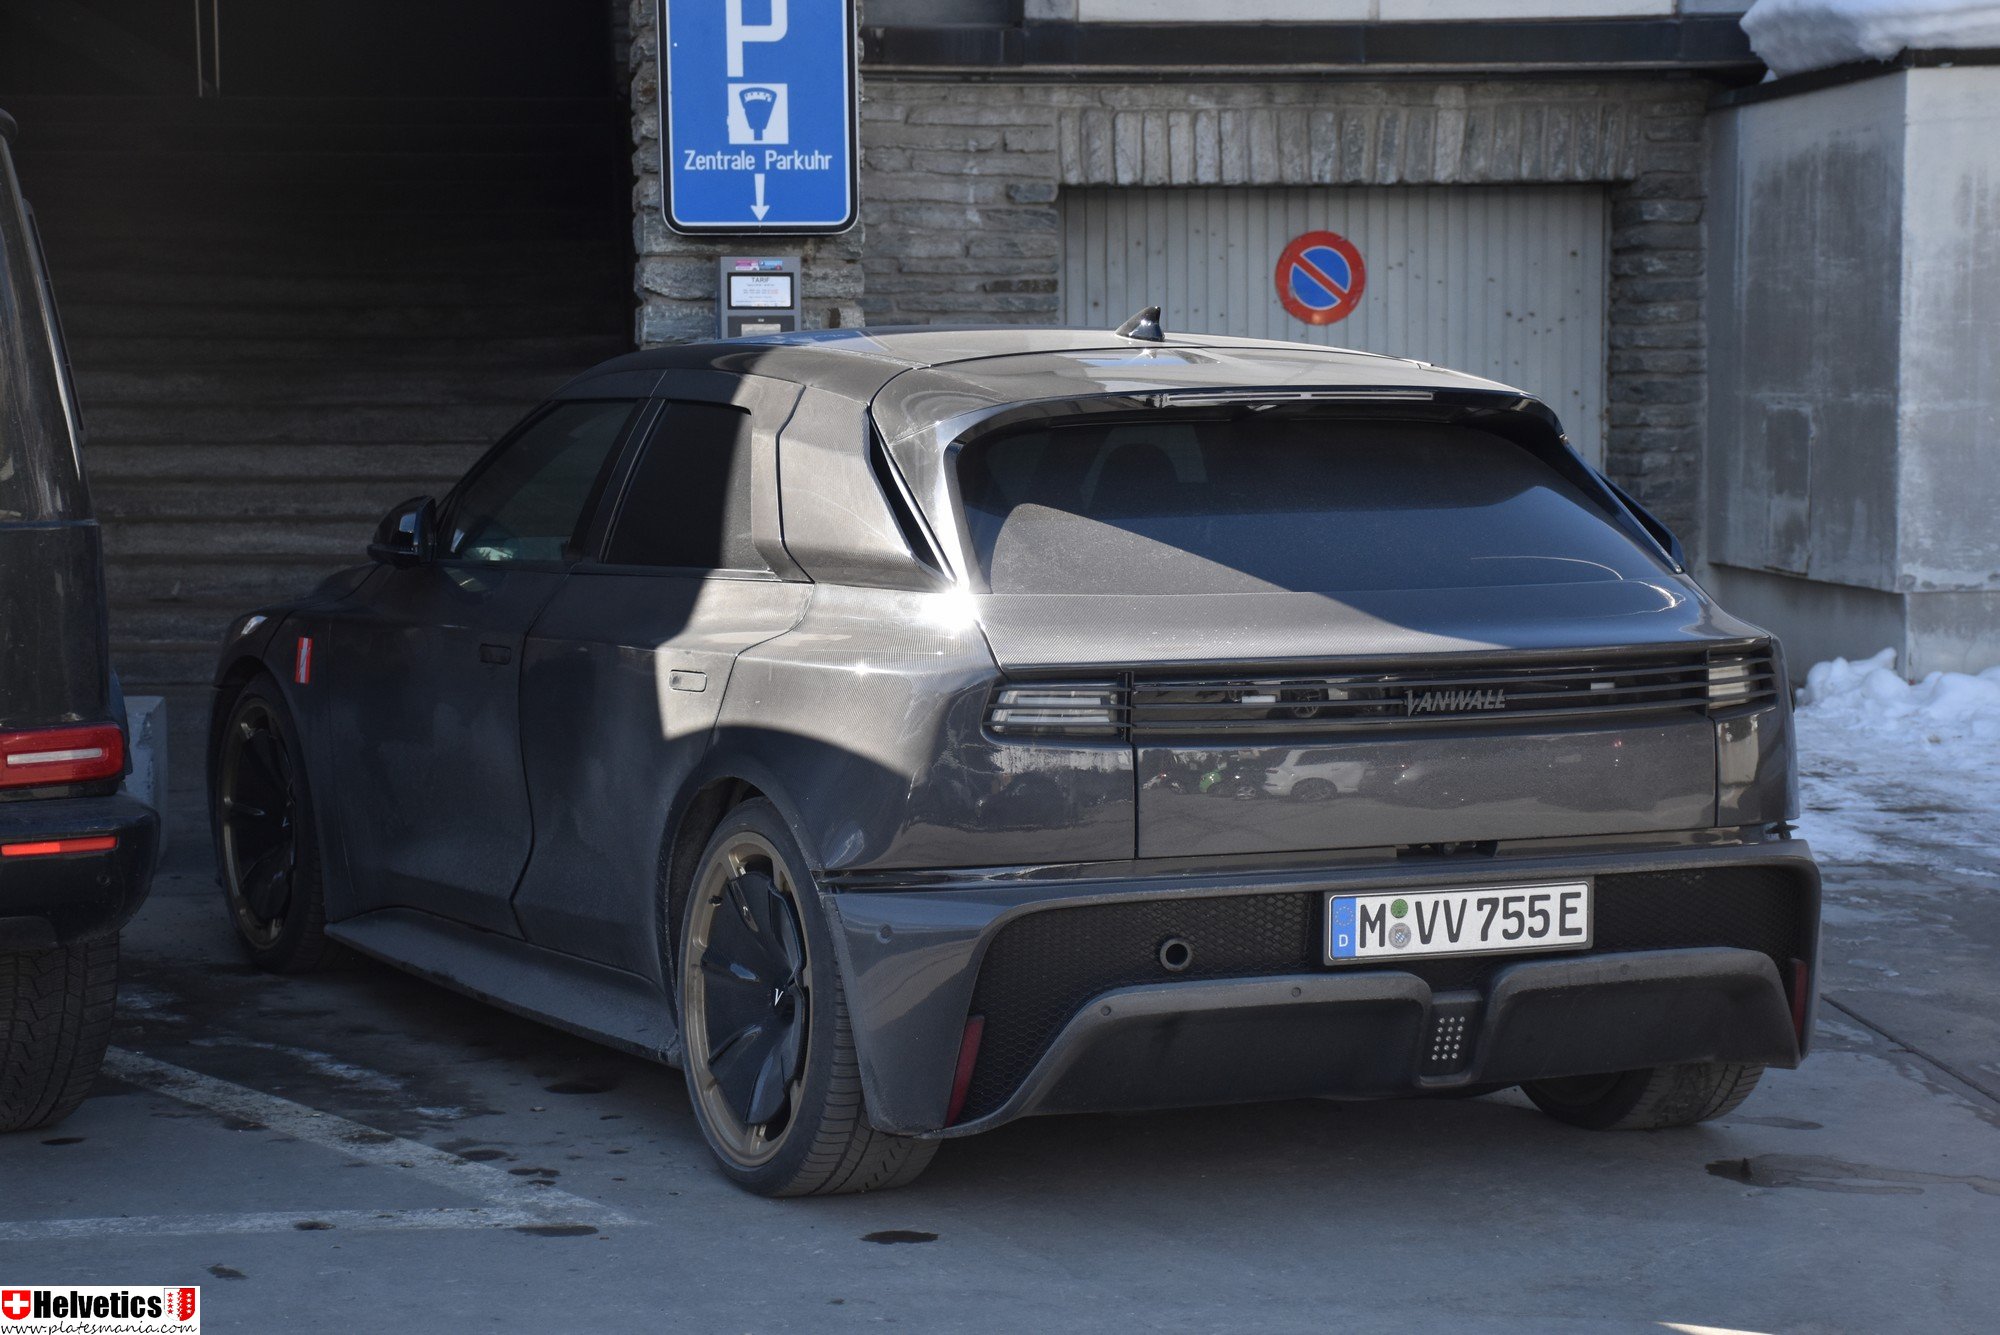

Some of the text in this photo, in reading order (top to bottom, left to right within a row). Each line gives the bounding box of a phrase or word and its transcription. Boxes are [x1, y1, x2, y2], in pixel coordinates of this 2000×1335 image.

[684, 150, 832, 170] Zentrale Parkuhr
[1405, 689, 1506, 717] VANWALL
[1359, 904, 1386, 948] M
[1339, 935, 1348, 947] D
